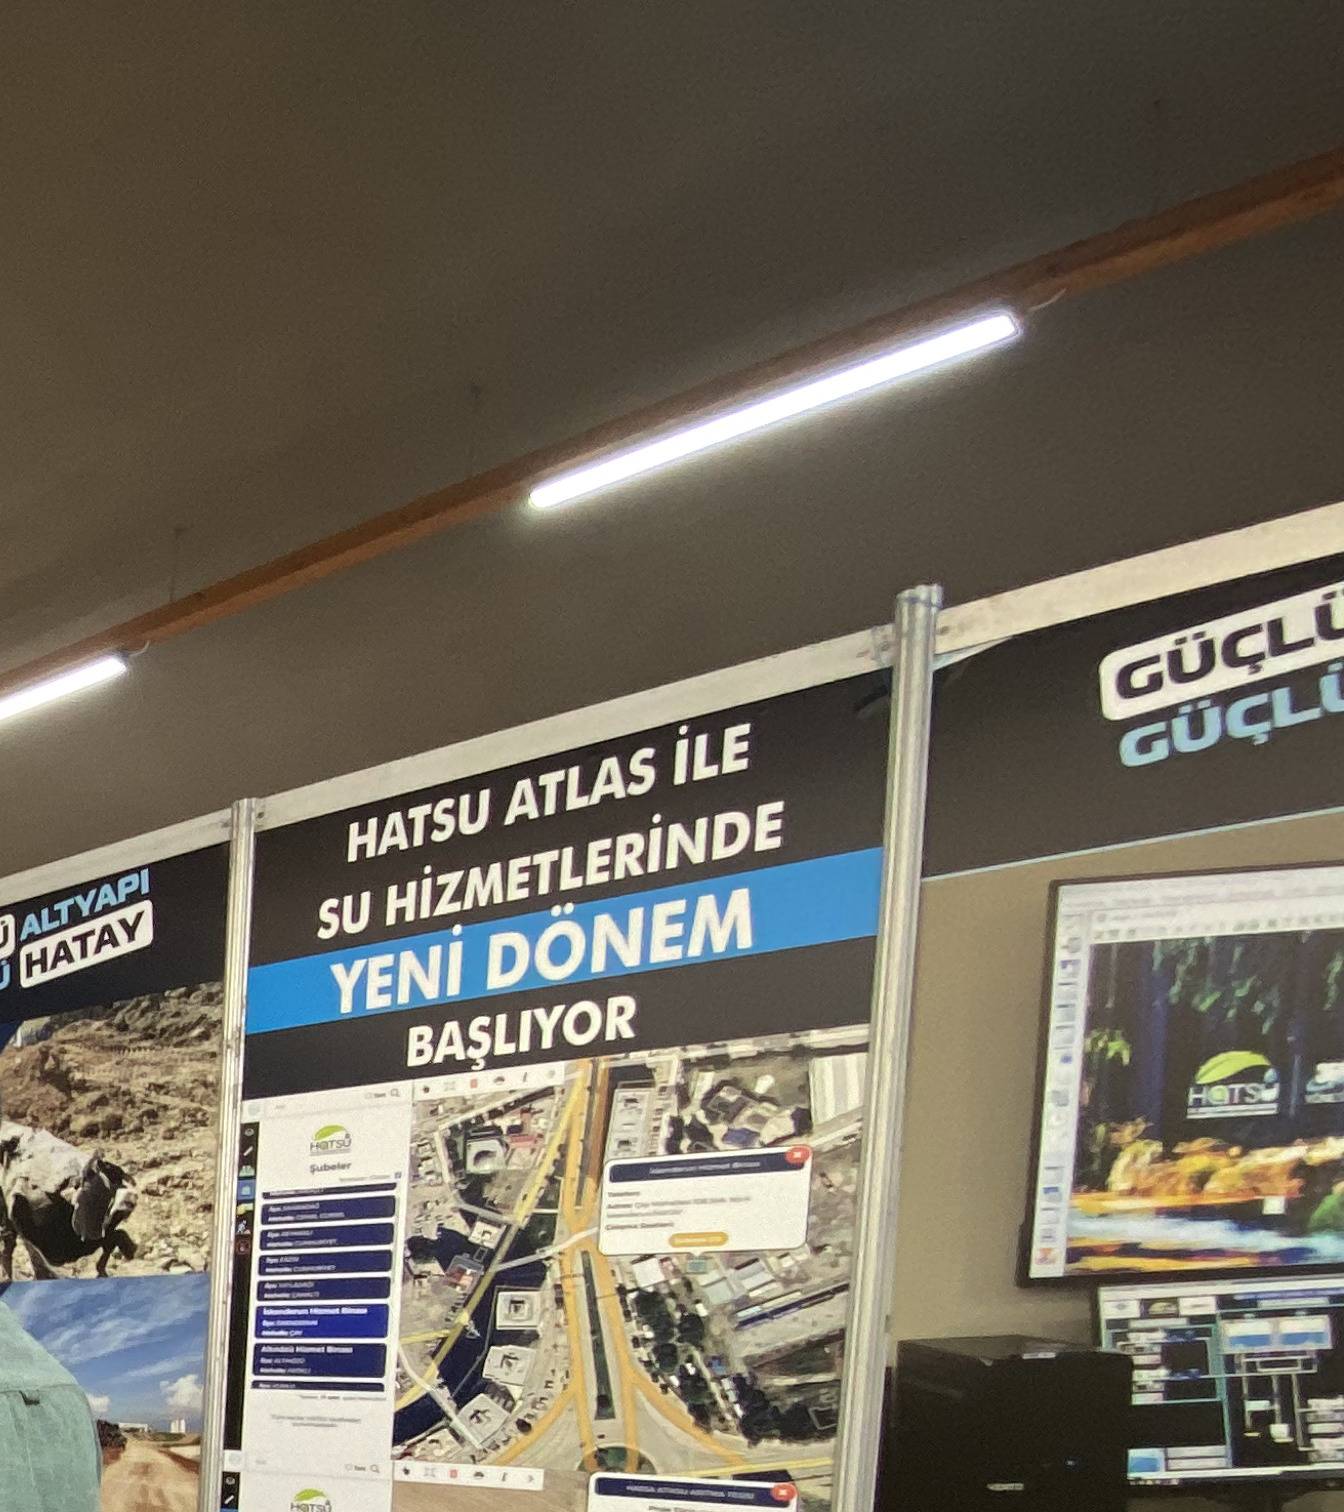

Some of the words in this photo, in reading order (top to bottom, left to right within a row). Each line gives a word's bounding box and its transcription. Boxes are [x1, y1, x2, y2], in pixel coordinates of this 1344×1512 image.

[347, 790, 491, 864] HATSU
[503, 747, 656, 827] ATLAS
[673, 723, 752, 787] İLE
[20, 867, 149, 942] ALTYAPI
[317, 889, 372, 941] SU
[384, 801, 786, 929] HİZMETLERİNDE
[24, 910, 145, 979] HATAY
[330, 924, 465, 1015] YENİ
[486, 888, 753, 993] DÖNEM
[406, 996, 638, 1071] BAŞLIYOR
[309, 1161, 352, 1176] Şubeler
